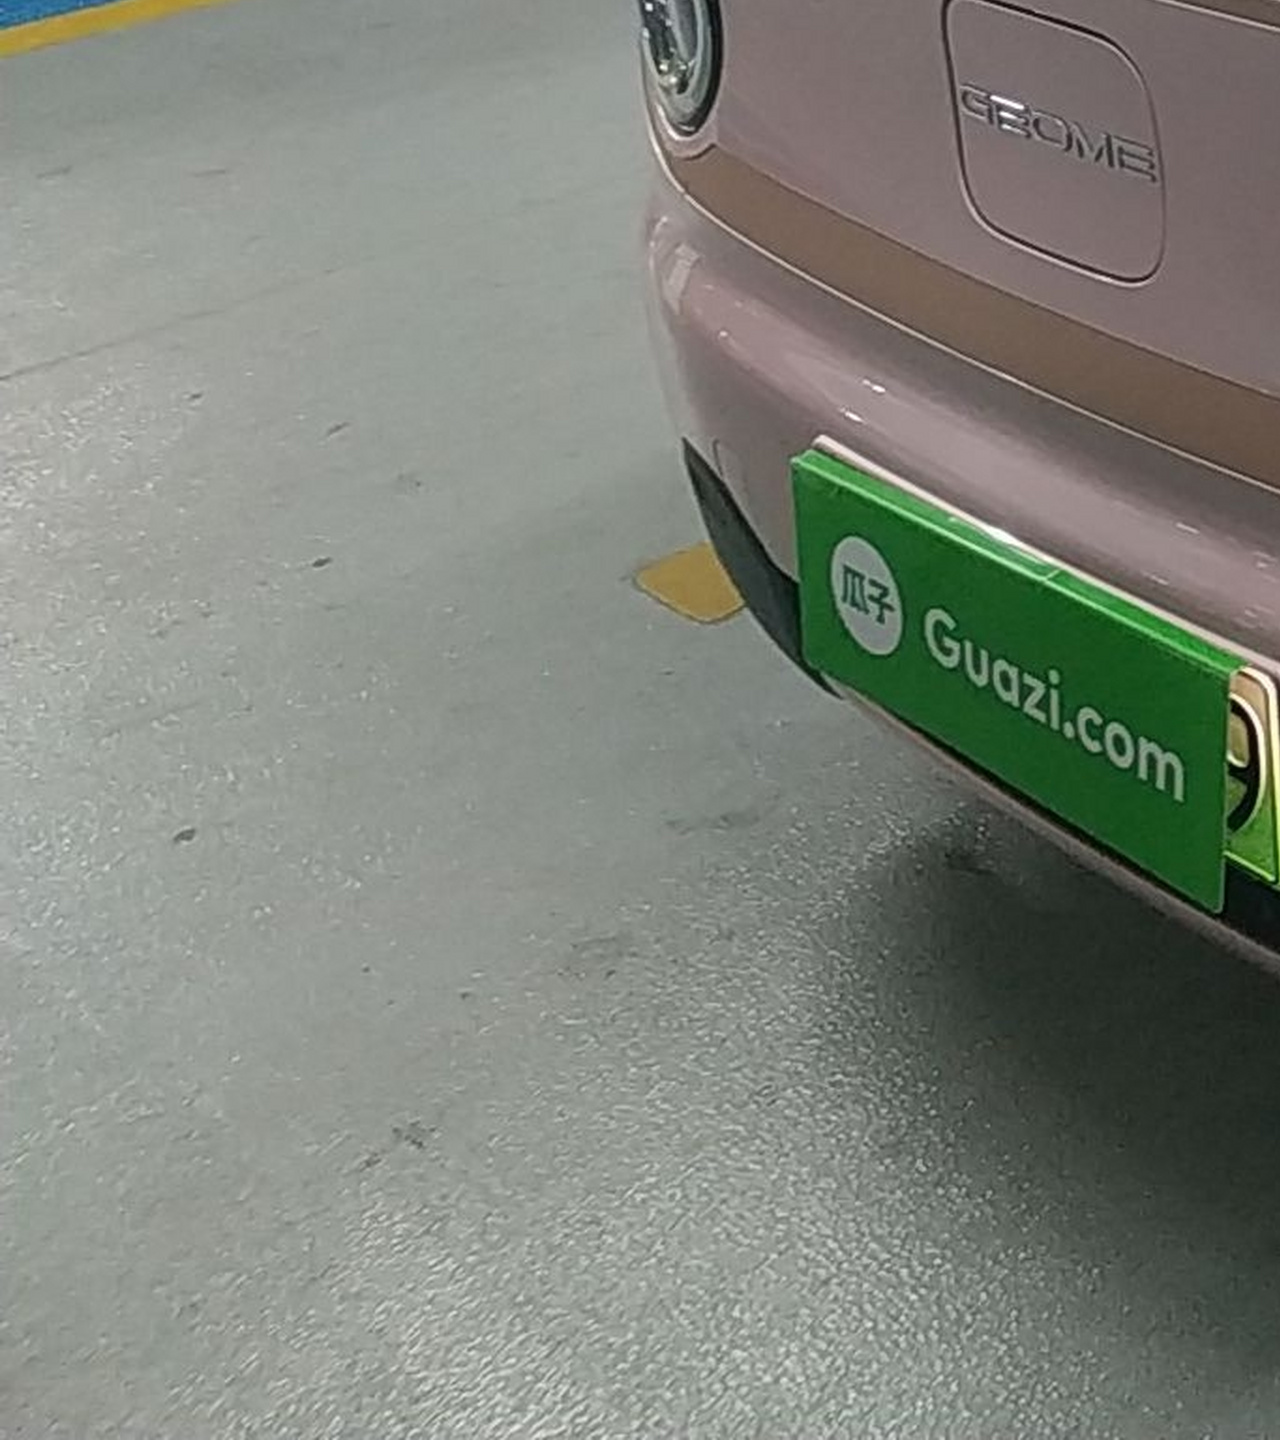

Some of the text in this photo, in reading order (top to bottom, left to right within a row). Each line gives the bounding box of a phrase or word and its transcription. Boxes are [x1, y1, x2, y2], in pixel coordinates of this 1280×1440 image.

[959, 83, 1157, 183] GEOME
[842, 564, 896, 625] 瓜子
[924, 608, 1185, 802] Guazi.com
